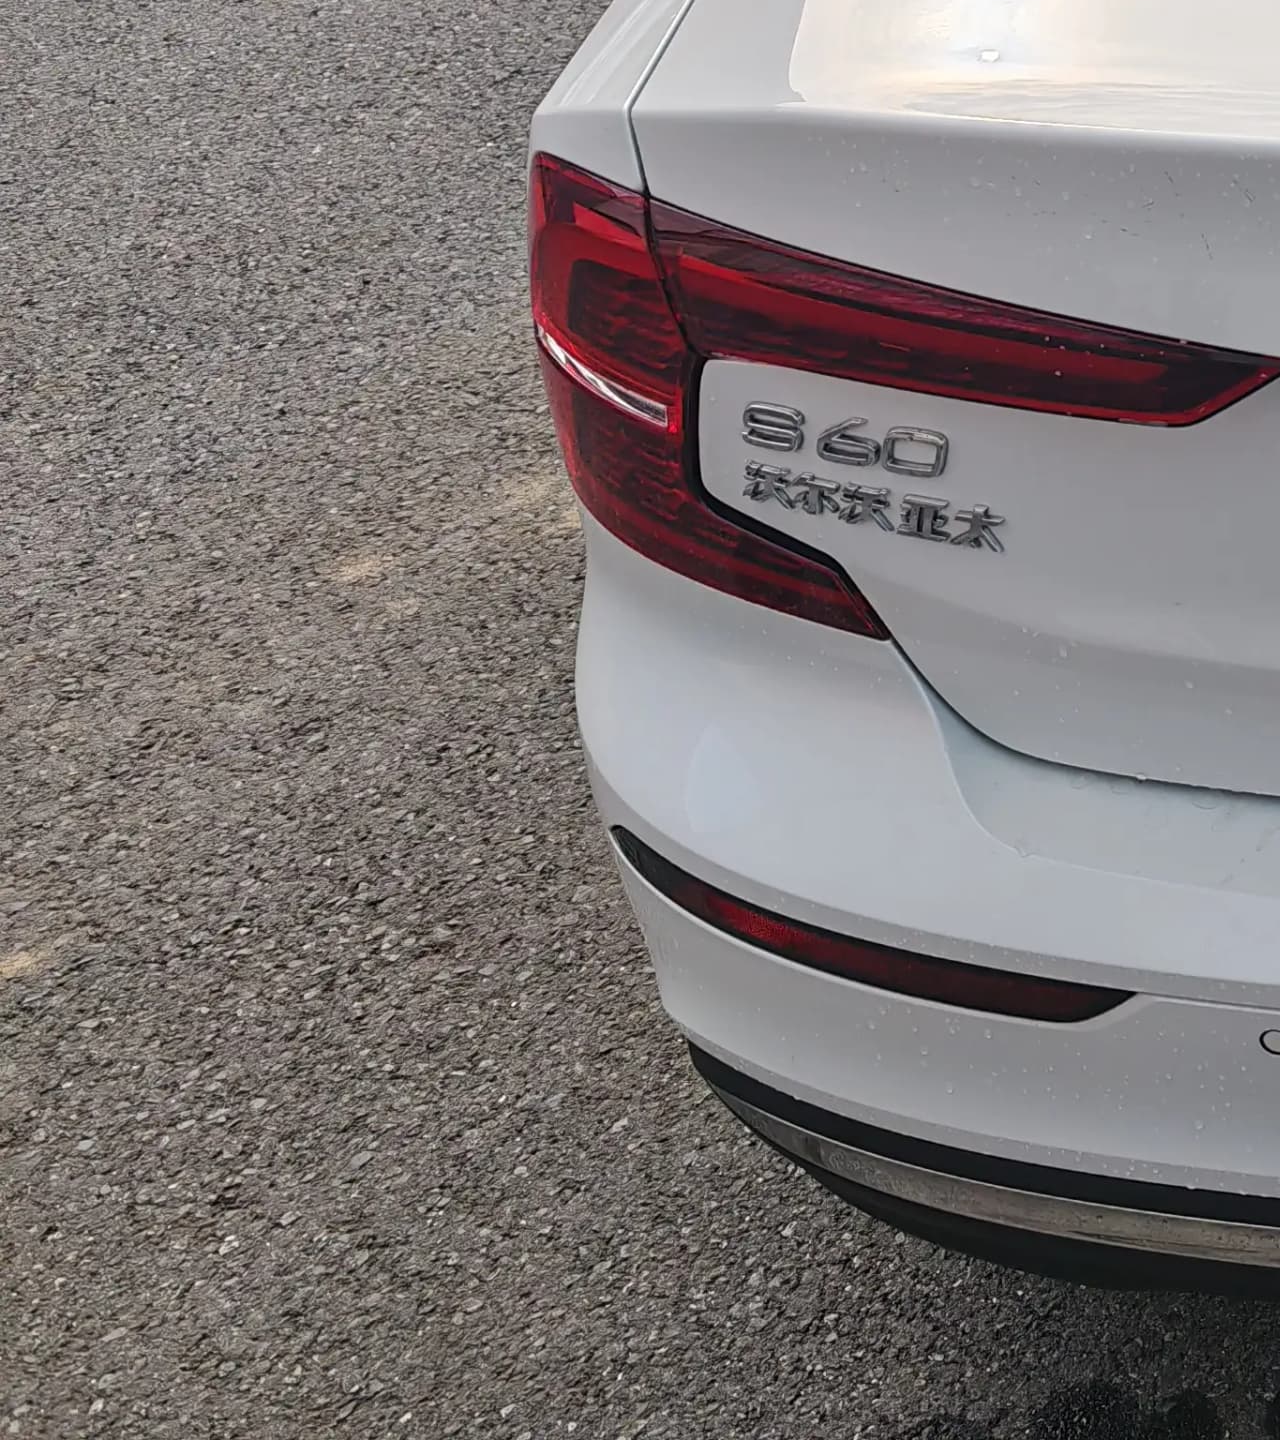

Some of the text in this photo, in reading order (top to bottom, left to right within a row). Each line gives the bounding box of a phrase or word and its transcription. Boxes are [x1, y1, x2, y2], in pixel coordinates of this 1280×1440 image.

[742, 401, 949, 478] S60
[743, 459, 1006, 553] 沃尔沃亚太
